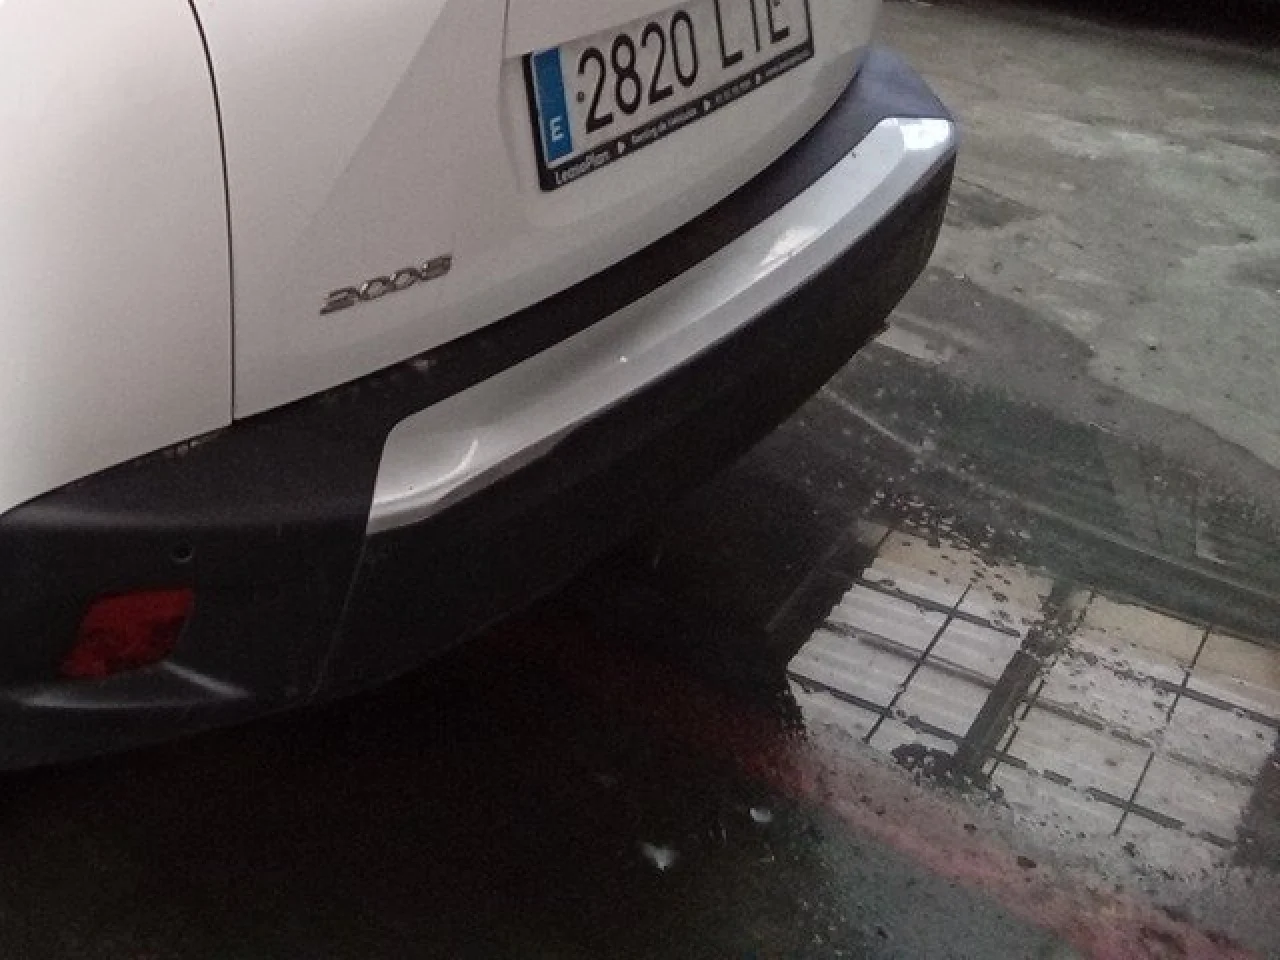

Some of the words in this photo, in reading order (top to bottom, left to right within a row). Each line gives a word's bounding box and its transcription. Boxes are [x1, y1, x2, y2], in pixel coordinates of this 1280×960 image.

[577, 9, 699, 134] 2820
[550, 115, 565, 141] E
[320, 254, 453, 315] 2008
